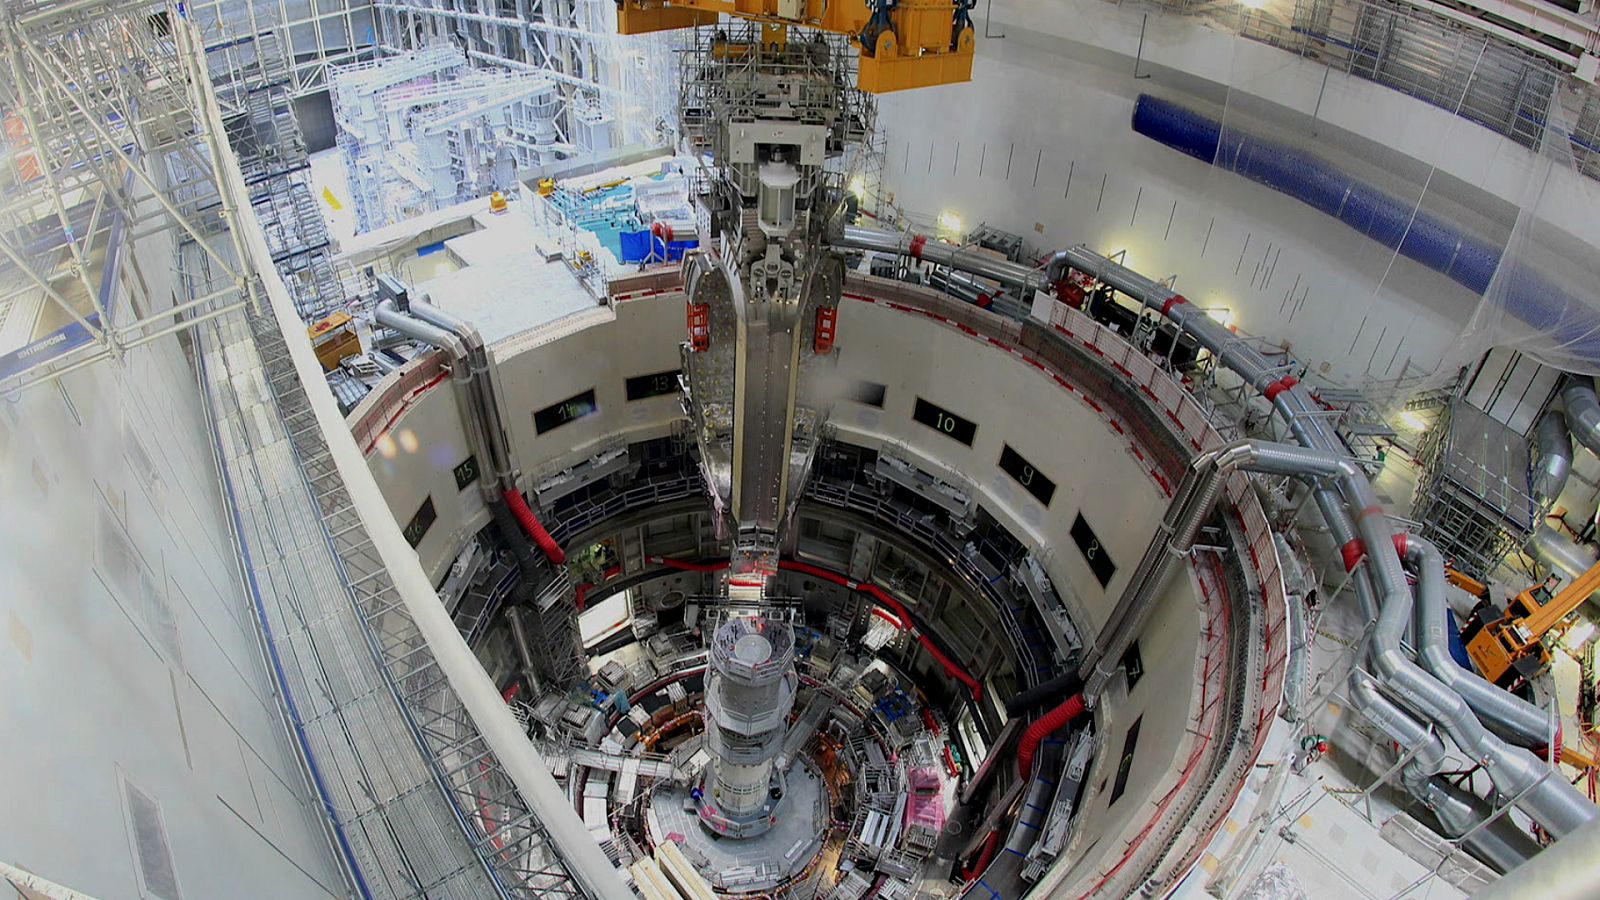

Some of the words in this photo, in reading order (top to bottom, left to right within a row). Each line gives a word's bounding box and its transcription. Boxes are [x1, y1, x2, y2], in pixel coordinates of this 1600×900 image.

[652, 376, 669, 391] 13
[558, 403, 574, 420] 14
[937, 412, 956, 433] 10
[457, 462, 473, 481] 15
[1020, 465, 1034, 486] 9
[407, 518, 421, 541] 16
[1087, 539, 1099, 560] 8
